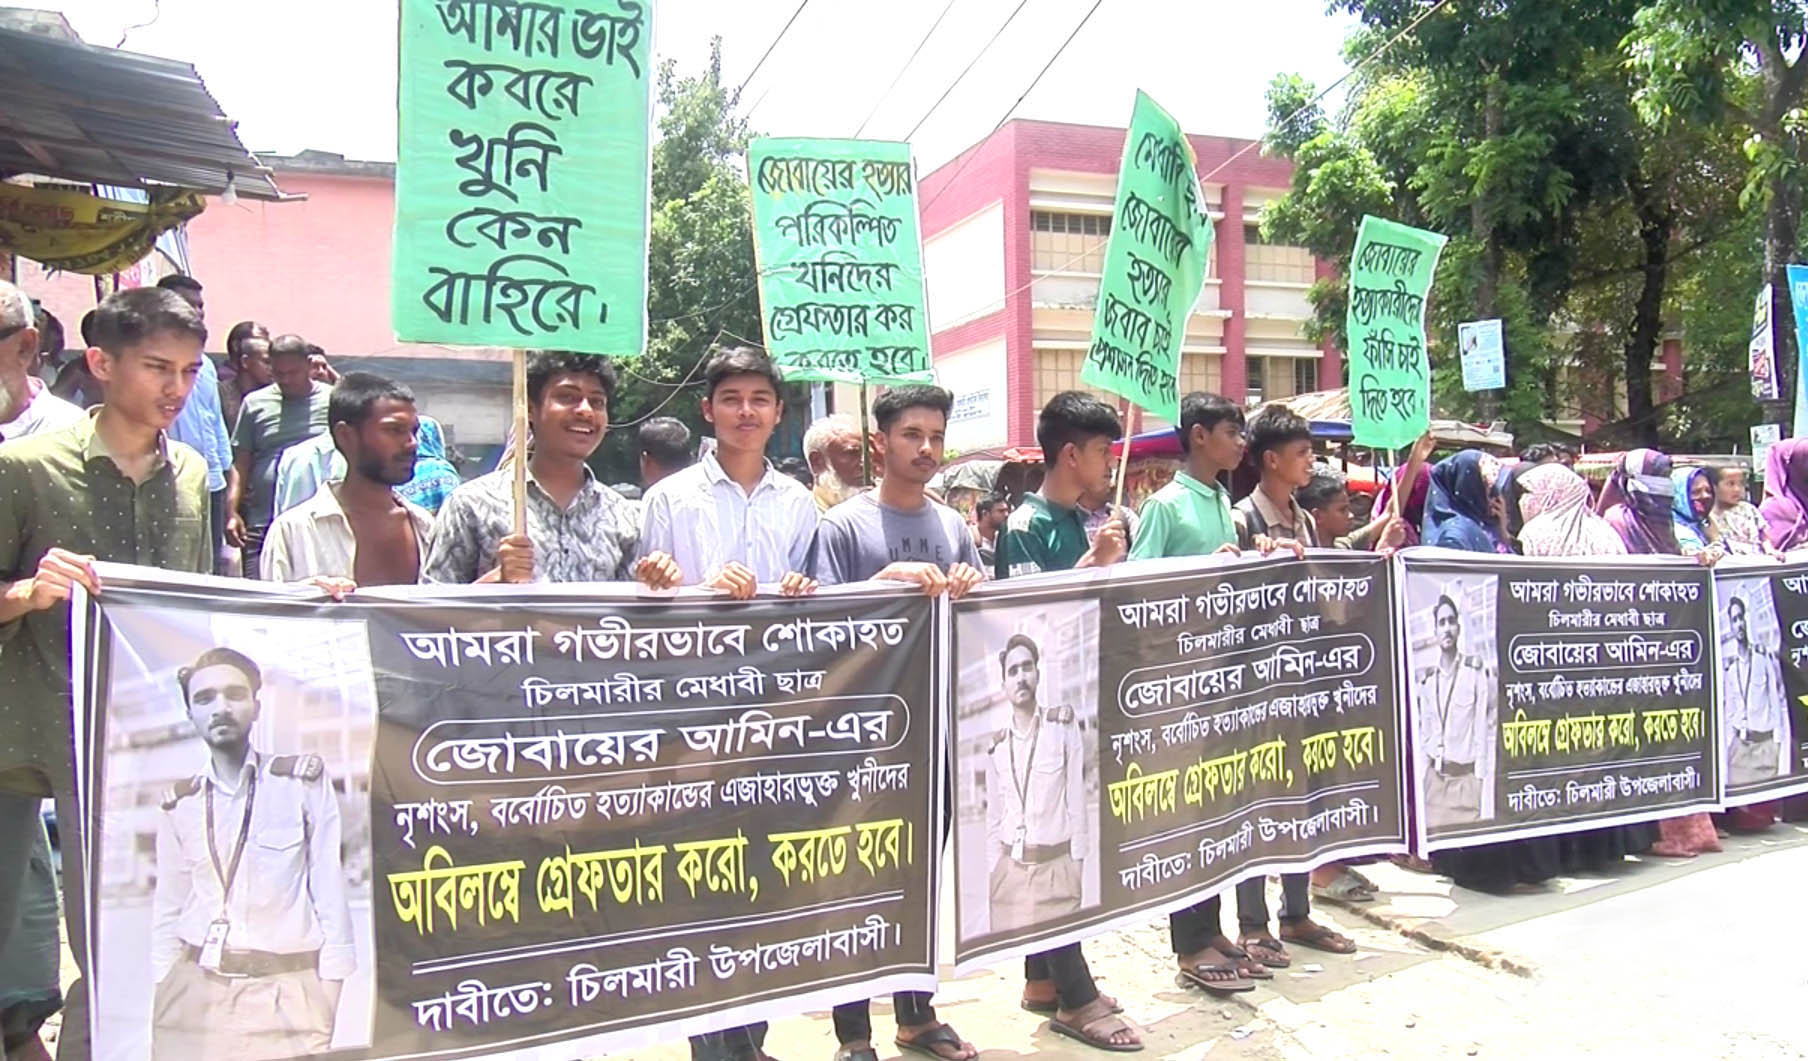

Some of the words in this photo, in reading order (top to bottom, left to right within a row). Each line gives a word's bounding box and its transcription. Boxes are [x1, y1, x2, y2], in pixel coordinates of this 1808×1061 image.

[436, 0, 565, 58] আমার
[571, 0, 644, 79] ভাই
[444, 60, 594, 120] কবরে
[449, 121, 562, 203] খুনি
[758, 156, 857, 196] জোবায়ের
[861, 160, 912, 201] হত্যার
[446, 207, 582, 255] কেন
[776, 199, 902, 247] পরিকল্পিত
[770, 303, 870, 341] গ্রেফতার
[875, 304, 915, 332] কর
[1104, 293, 1151, 349] জবাব
[1398, 334, 1422, 380] চাই
[1360, 373, 1387, 424] দিতে
[1118, 594, 1190, 630] আমরা
[1196, 582, 1289, 620] গভীরভাবে
[1294, 576, 1373, 603] শোকাহত
[400, 626, 542, 667] আমরা
[554, 616, 752, 662] গভীরভাবে
[763, 616, 909, 652] শোকাহত
[1177, 625, 1244, 655] চিলমারীর
[1251, 614, 1294, 641] মেধাবী
[1298, 614, 1321, 633] ছাত্র
[520, 673, 665, 707] চিলমারীর
[676, 666, 766, 698] মেধাবী
[772, 668, 827, 694] ছাত্র
[1125, 663, 1245, 708] জোবায়ের
[1252, 645, 1362, 684] আমিন-এর
[427, 725, 667, 773] জোবায়ের
[678, 710, 894, 755] আমিন-এর
[393, 797, 479, 848] নৃশংস,
[847, 757, 911, 802] খুনীদের
[1108, 762, 1179, 825] অবিলম্বে
[1183, 748, 1248, 807] গ্রেফতার
[1250, 735, 1294, 789] করো,
[1301, 731, 1339, 776] করতে
[1198, 822, 1254, 869] চিলমারী
[387, 845, 526, 936] অবিলম্বে
[536, 838, 667, 919] গ্রেফতার
[673, 828, 758, 902] করো,
[768, 826, 852, 887] করতে
[856, 819, 913, 877] হবে।
[412, 979, 553, 1031] দাবীতে:
[566, 946, 701, 1007] চিলমারী
[709, 914, 901, 980] উপজেলাবাসী।
